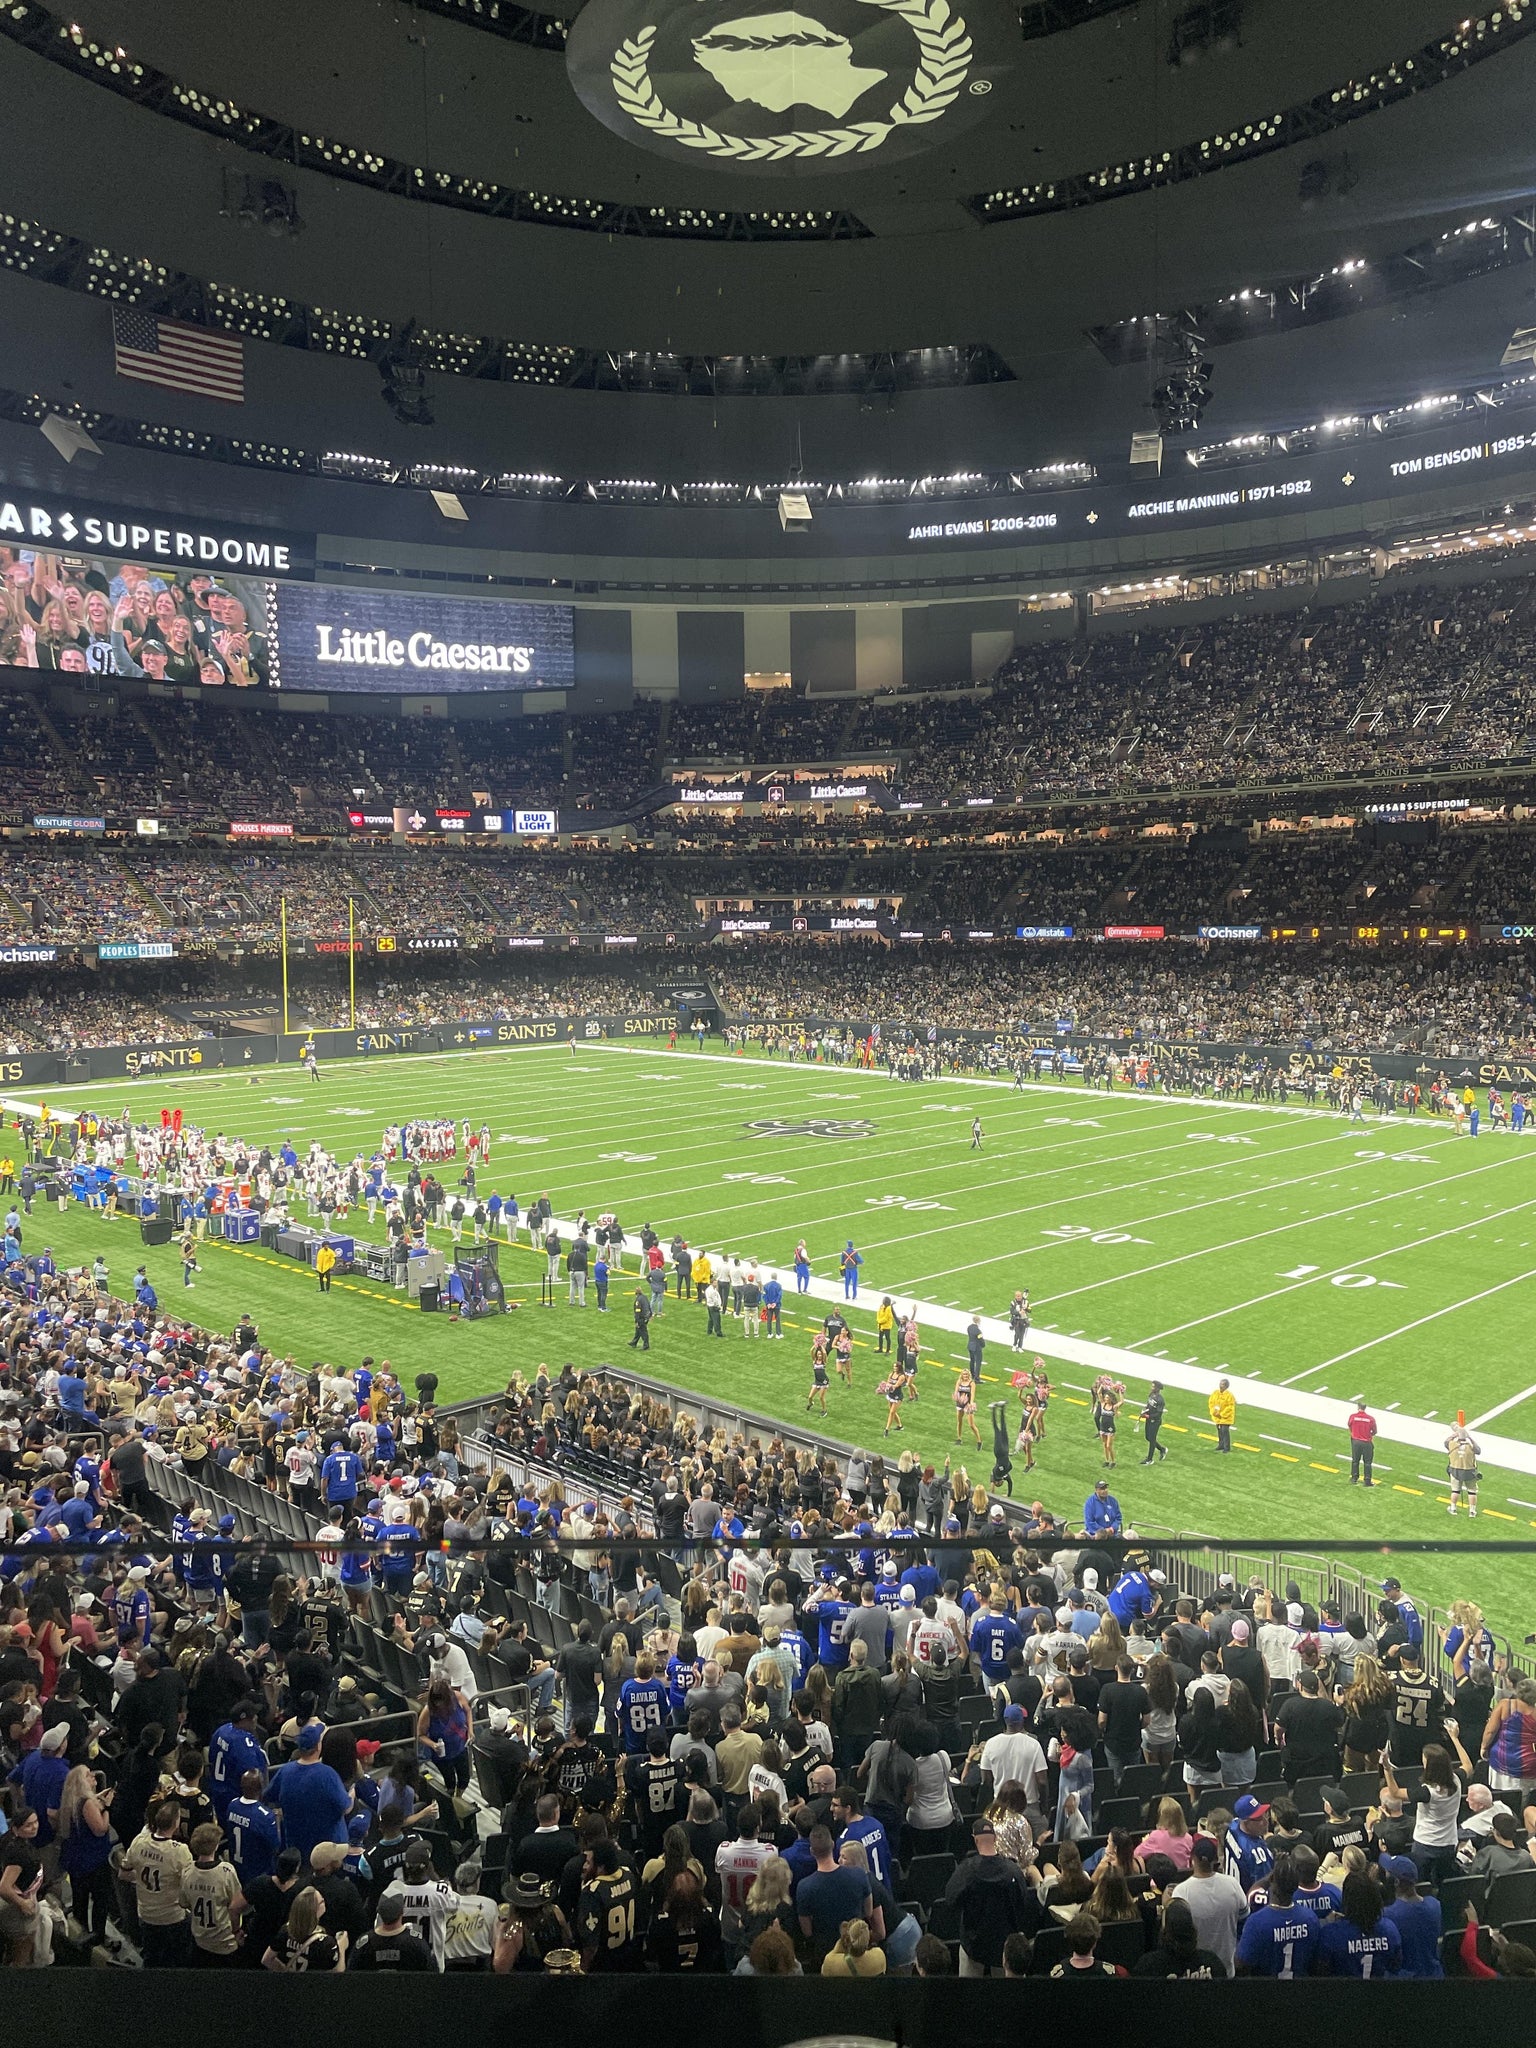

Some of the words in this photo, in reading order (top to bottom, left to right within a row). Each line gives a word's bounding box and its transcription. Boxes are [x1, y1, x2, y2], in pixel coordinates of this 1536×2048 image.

[1390, 460, 1420, 476] TOM
[1422, 448, 1482, 472] BENSON
[1128, 499, 1174, 518] ARCHIE
[1176, 492, 1239, 514] MANNING
[1247, 480, 1312, 500] 1971-1982
[908, 522, 942, 539] JAHRI
[944, 519, 984, 536] EVANS
[990, 513, 1057, 531] 2006-2016
[84, 518, 290, 570] SUPERDOME
[316, 624, 404, 666] Little
[407, 632, 535, 673] Caesars
[680, 788, 705, 801] Little
[705, 790, 744, 801] Caesars
[811, 786, 836, 798] Little
[836, 785, 867, 797] Caesars
[1364, 803, 1413, 813] CAESARS
[1413, 799, 1470, 810] SUPERDOME
[35, 819, 72, 827] VENTURE
[73, 819, 105, 828] GLOBAL
[363, 815, 393, 824] TOYOTA
[440, 818, 465, 829] 0:32
[523, 813, 547, 822] BUD
[232, 824, 259, 833] ROUSES
[260, 824, 293, 834] MARKETS
[519, 822, 551, 831] LIGHT
[737, 919, 770, 930] Caesars
[831, 918, 854, 929] Little
[1107, 926, 1143, 937] Community
[1208, 926, 1259, 939] Ochsner
[1311, 928, 1319, 938] 0
[1419, 928, 1428, 938] 0
[1502, 926, 1535, 938] COX
[101, 946, 138, 957] PEOPLES
[140, 944, 171, 955] HEALTH
[183, 942, 217, 951] SAINTS
[379, 938, 394, 950] 25
[408, 938, 459, 949] CAESARS
[0, 948, 56, 962] chsner
[191, 1006, 280, 1018] SAINTS
[498, 1022, 557, 1041] SAINTS
[624, 1017, 677, 1034] SAINTS
[598, 1151, 658, 1163] 50
[721, 1171, 786, 1185] 40
[865, 1195, 940, 1211] 30
[602, 1216, 613, 1225] 59
[1040, 1224, 1132, 1244] 20
[1275, 1263, 1378, 1288] 10
[355, 1380, 360, 1393] 1
[356, 1431, 367, 1445] 13
[275, 1444, 284, 1463] 9
[290, 1457, 301, 1472] 10
[339, 1461, 348, 1482] 1
[212, 1553, 222, 1576] 8
[320, 1550, 337, 1566] 10
[450, 1571, 462, 1593] 7
[731, 1570, 747, 1594] 10
[1115, 1578, 1132, 1594] 1
[116, 1605, 132, 1624] 97
[304, 1614, 329, 1642] 12
[991, 1628, 1005, 1637] DART
[991, 1638, 1004, 1661] 6
[677, 1673, 694, 1689] 92
[630, 1690, 658, 1703] BAVARO
[630, 1703, 661, 1733] 89
[1396, 1695, 1429, 1727] 24
[803, 1753, 821, 1772] GRAHAM
[754, 1771, 771, 1787] BREES
[648, 1778, 678, 1813] 87
[228, 1811, 251, 1828] NABERS
[233, 1825, 244, 1865] 1
[1332, 1829, 1363, 1848] MANNING
[140, 1849, 165, 1864] KAMARA
[733, 1858, 759, 1868] MANNING
[1251, 1847, 1266, 1865] 10
[872, 1847, 883, 1882] 1
[140, 1865, 161, 1893] 41
[189, 1883, 216, 1894] KAMARA
[1296, 1895, 1331, 1914] TAYLOR
[193, 1897, 216, 1929] 41
[445, 1912, 484, 1944] Saints
[1274, 1923, 1308, 1943] NABERS
[1348, 1937, 1389, 1953] NABERS
[678, 1942, 699, 1968] 7
[1278, 1942, 1294, 1980] 1
[1360, 1953, 1374, 1980] 1
